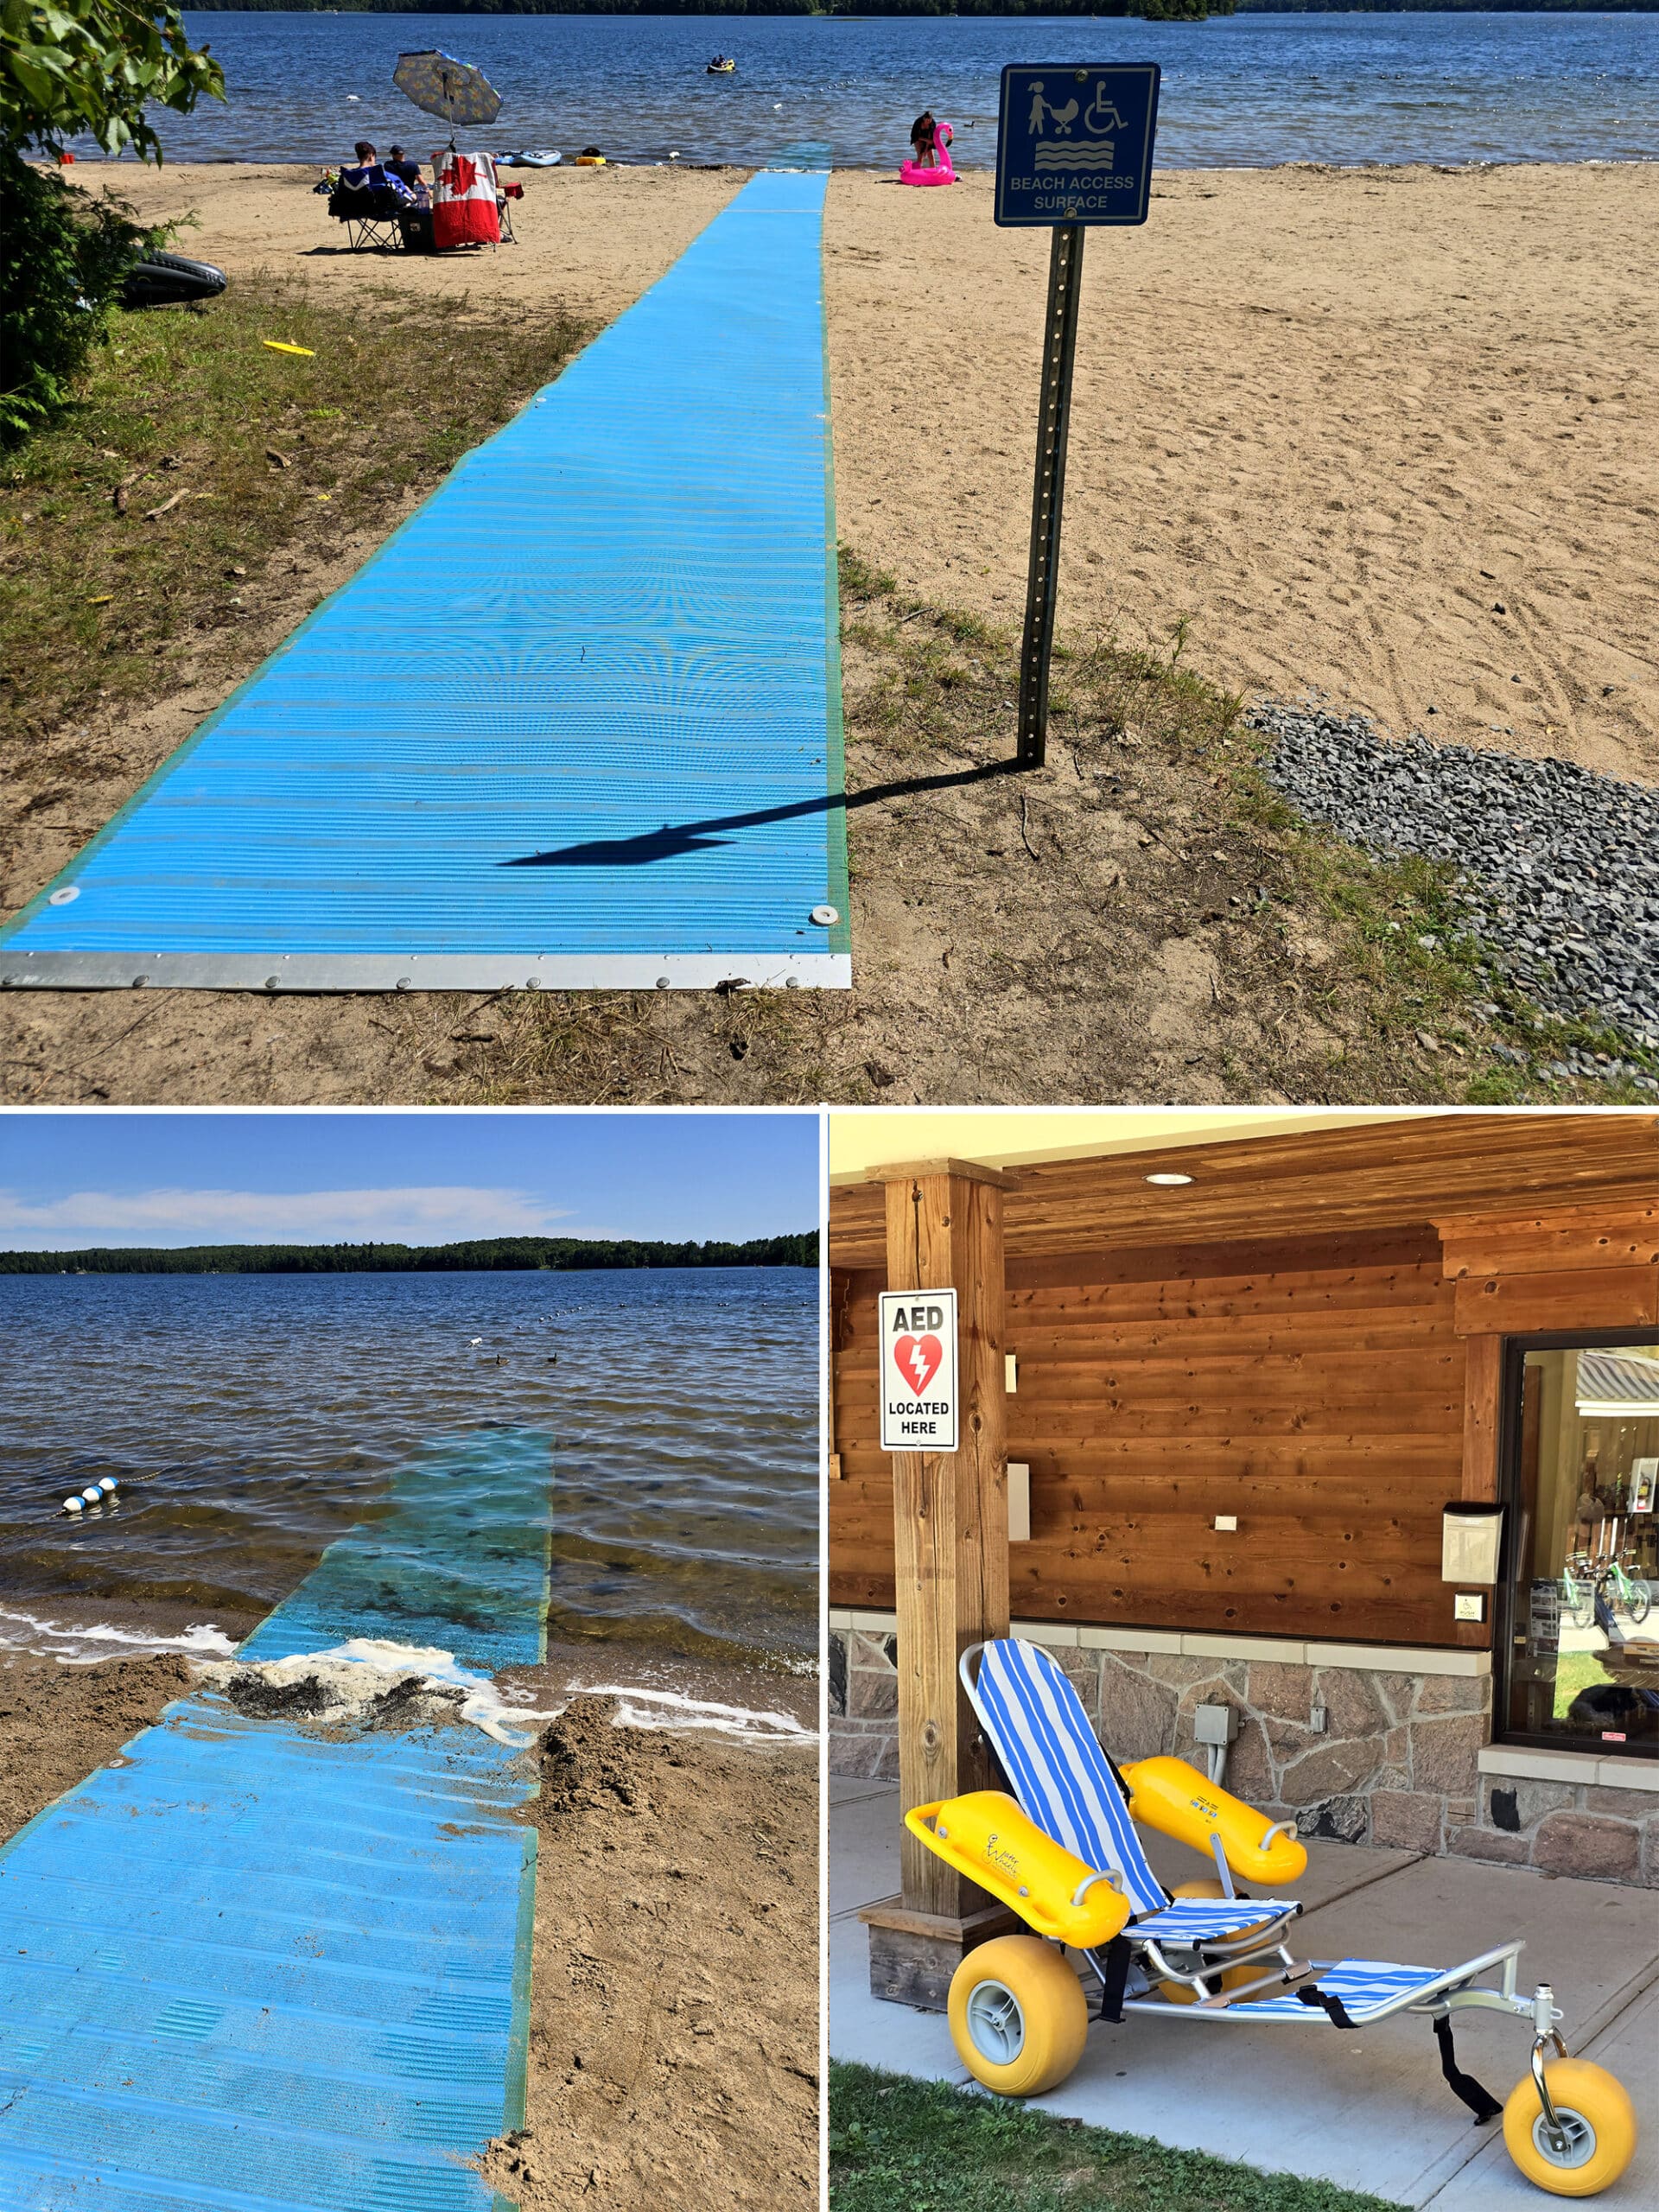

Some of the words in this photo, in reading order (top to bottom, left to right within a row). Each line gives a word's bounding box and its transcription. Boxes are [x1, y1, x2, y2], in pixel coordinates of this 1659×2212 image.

[1011, 177, 1065, 190] BEACH
[1069, 176, 1135, 189] ACCESS
[1033, 195, 1108, 209] SURFACE
[893, 1306, 944, 1332] AED
[889, 1402, 949, 1415] LOCATED
[901, 1421, 937, 1434] HERE
